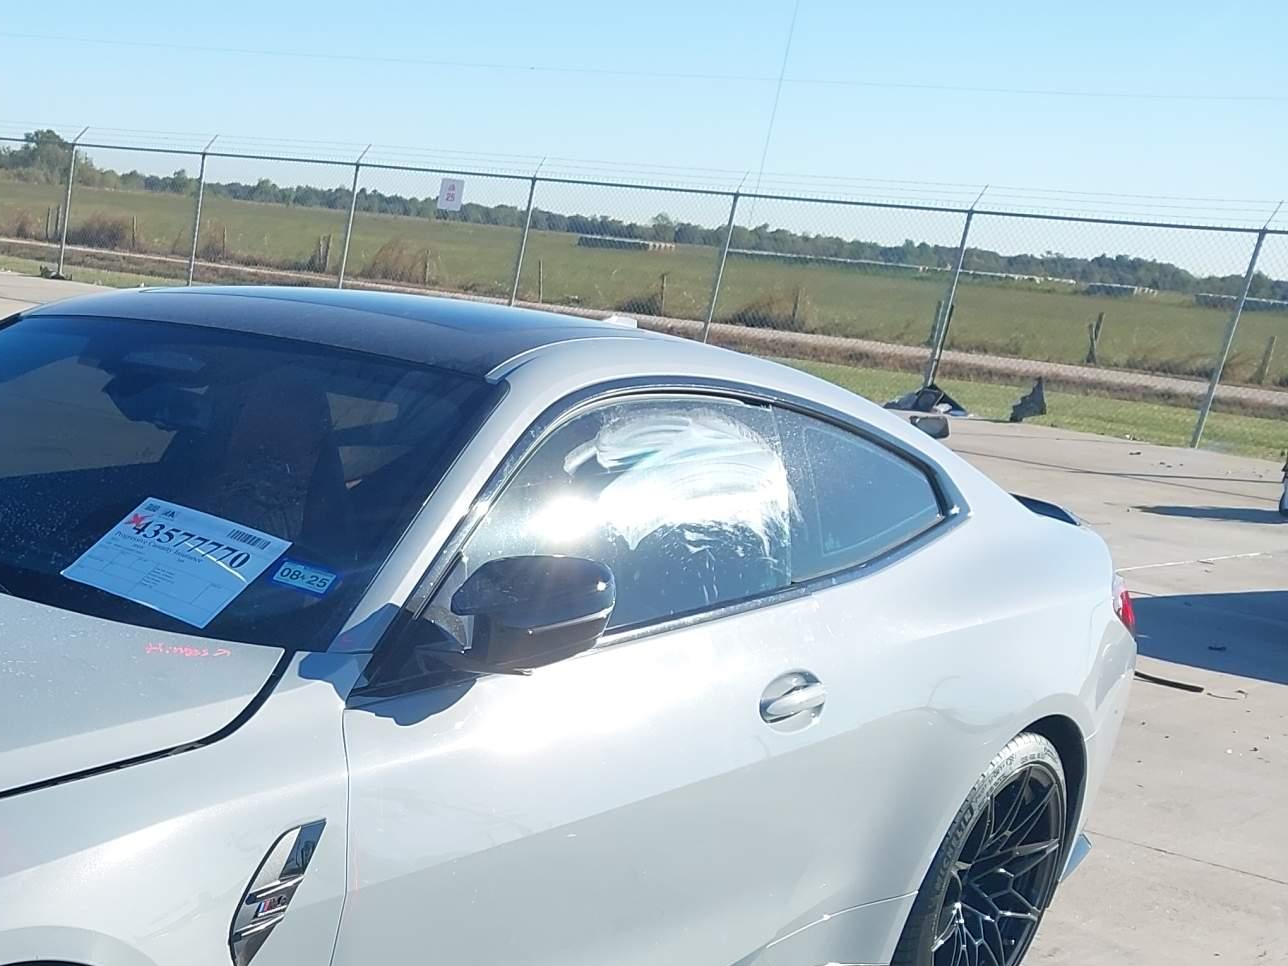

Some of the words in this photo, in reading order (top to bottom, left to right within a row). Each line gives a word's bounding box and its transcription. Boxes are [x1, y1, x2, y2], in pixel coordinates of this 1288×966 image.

[132, 519, 251, 569] 43577770
[280, 567, 302, 580] 08
[306, 575, 330, 588] 25
